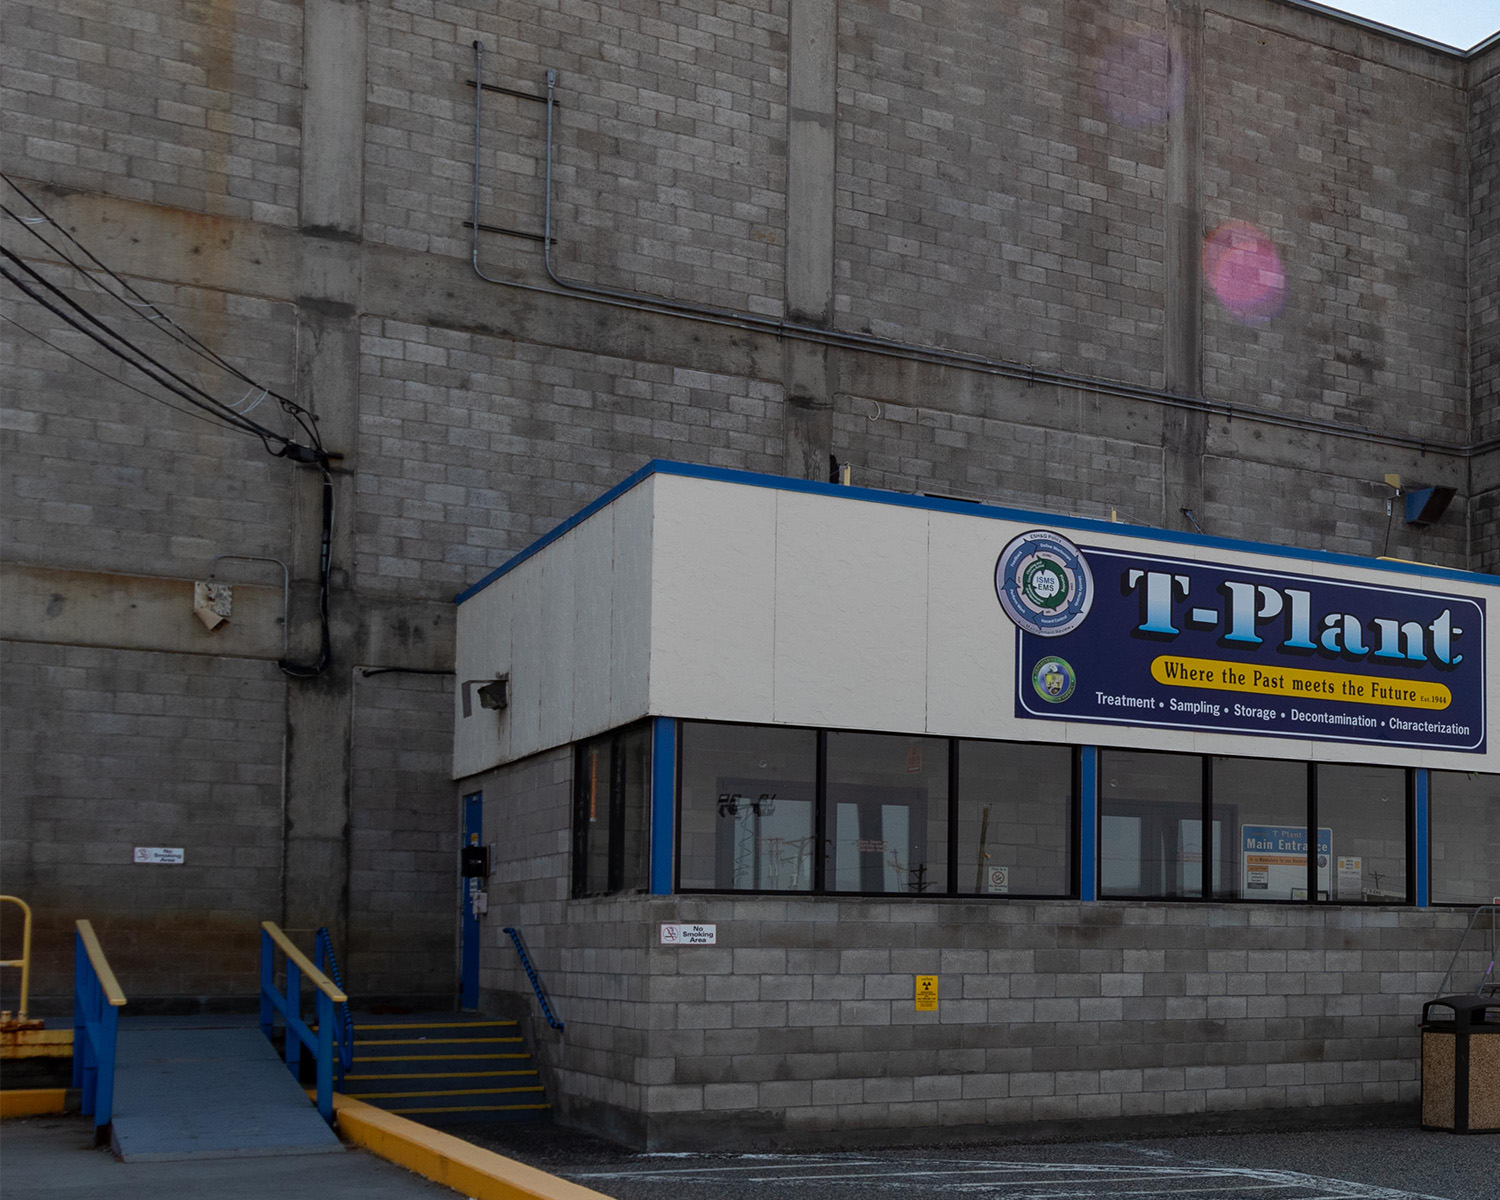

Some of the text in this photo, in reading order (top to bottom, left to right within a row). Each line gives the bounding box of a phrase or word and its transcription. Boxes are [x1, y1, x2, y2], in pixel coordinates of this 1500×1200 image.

[1036, 576, 1055, 585] ISMS
[1037, 584, 1054, 592] EMS
[1127, 568, 1463, 666] T-Plant
[1164, 661, 1214, 682] Where
[1222, 668, 1246, 685] the
[1253, 670, 1285, 689] Past
[1292, 679, 1335, 694] meets
[1341, 680, 1364, 697] the
[1371, 683, 1416, 701] Future
[1095, 691, 1155, 709] Treatment
[1169, 698, 1220, 717] Sampling
[1234, 704, 1276, 720] Storage
[1291, 709, 1377, 728] Decontamination
[1389, 717, 1470, 735] Characterization
[1246, 838, 1328, 852] Main Entrace
